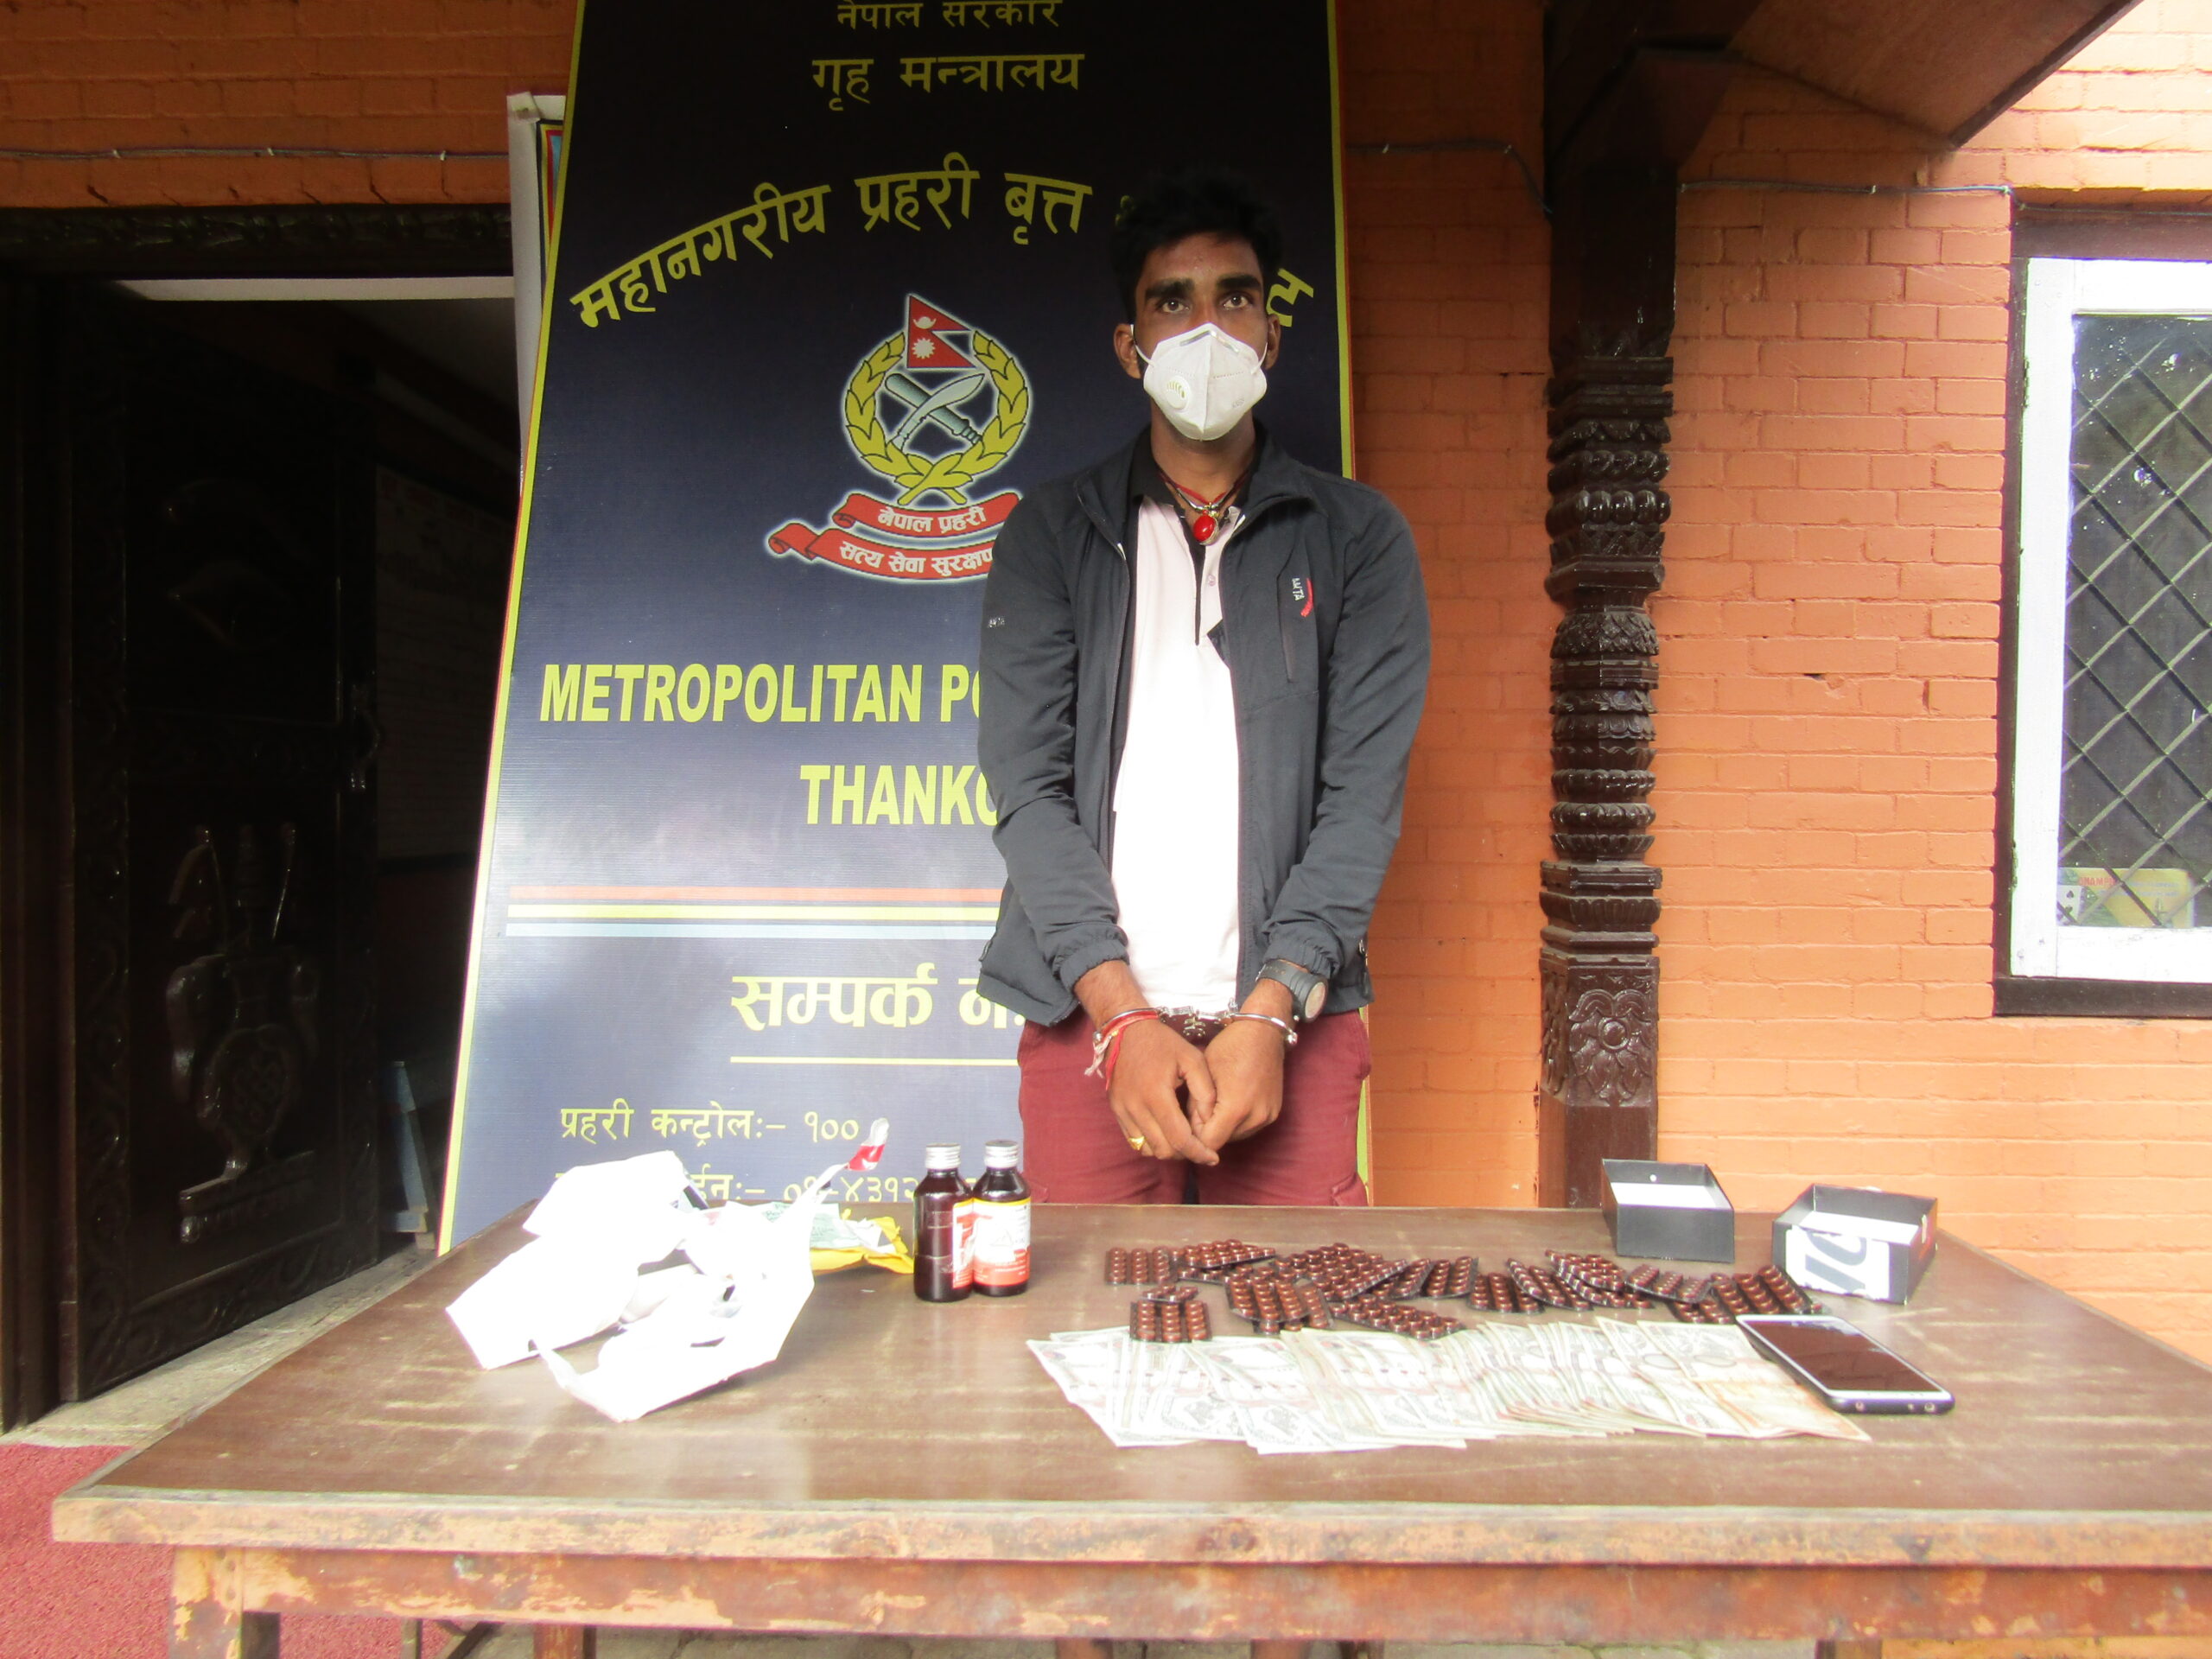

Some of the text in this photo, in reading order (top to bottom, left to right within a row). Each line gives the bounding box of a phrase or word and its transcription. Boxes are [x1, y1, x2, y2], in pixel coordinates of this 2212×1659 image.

[837, 0, 1063, 29] नेपाल सरकार
[812, 54, 1085, 111] गृह मन्त्रालय
[569, 182, 831, 327] महानगरीय
[854, 151, 980, 232] प्रहरी
[878, 506, 987, 533] नेपाल प्रहरी
[840, 541, 885, 568] सत्य
[889, 551, 926, 573] सेवा
[539, 663, 923, 722] METROPOLITAN
[731, 963, 938, 1031] सम्पर्क
[561, 1098, 634, 1144] प्रहरी
[804, 1111, 859, 1142] १००
